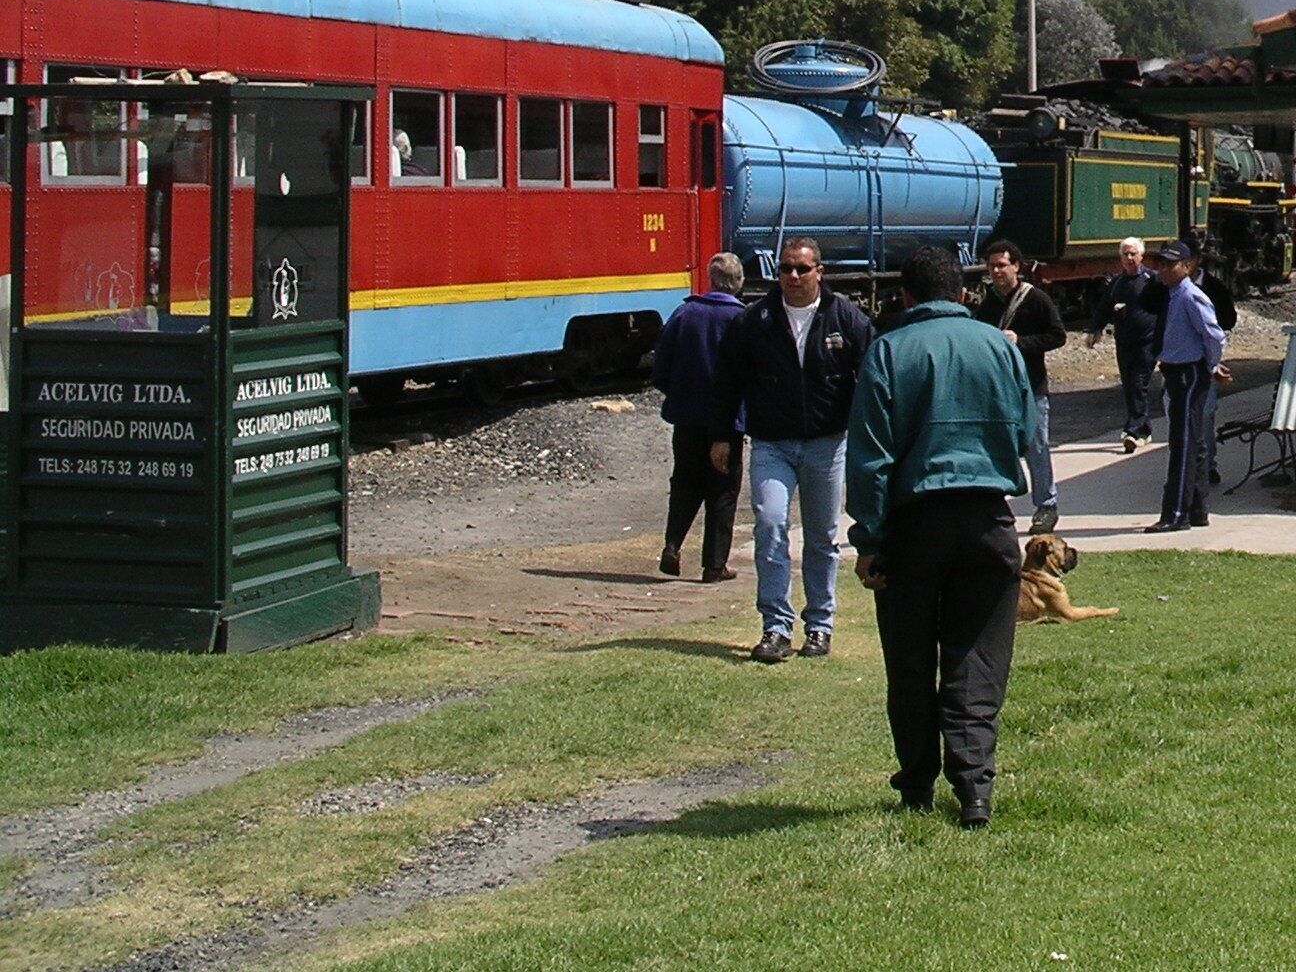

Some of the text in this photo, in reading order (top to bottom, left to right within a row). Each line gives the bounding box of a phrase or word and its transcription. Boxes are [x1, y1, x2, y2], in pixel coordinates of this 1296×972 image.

[643, 213, 664, 231] 1234
[38, 382, 191, 404] ACELVIG LTDA.
[237, 372, 331, 401] ACELVIG LTDA.
[41, 419, 195, 440] SEGURIDAD PRIVADA
[237, 405, 332, 437] SEGURIDAD PRIVADA
[38, 458, 194, 477] TELS: 248 75 32 248 69 19
[234, 456, 259, 475] TELS:
